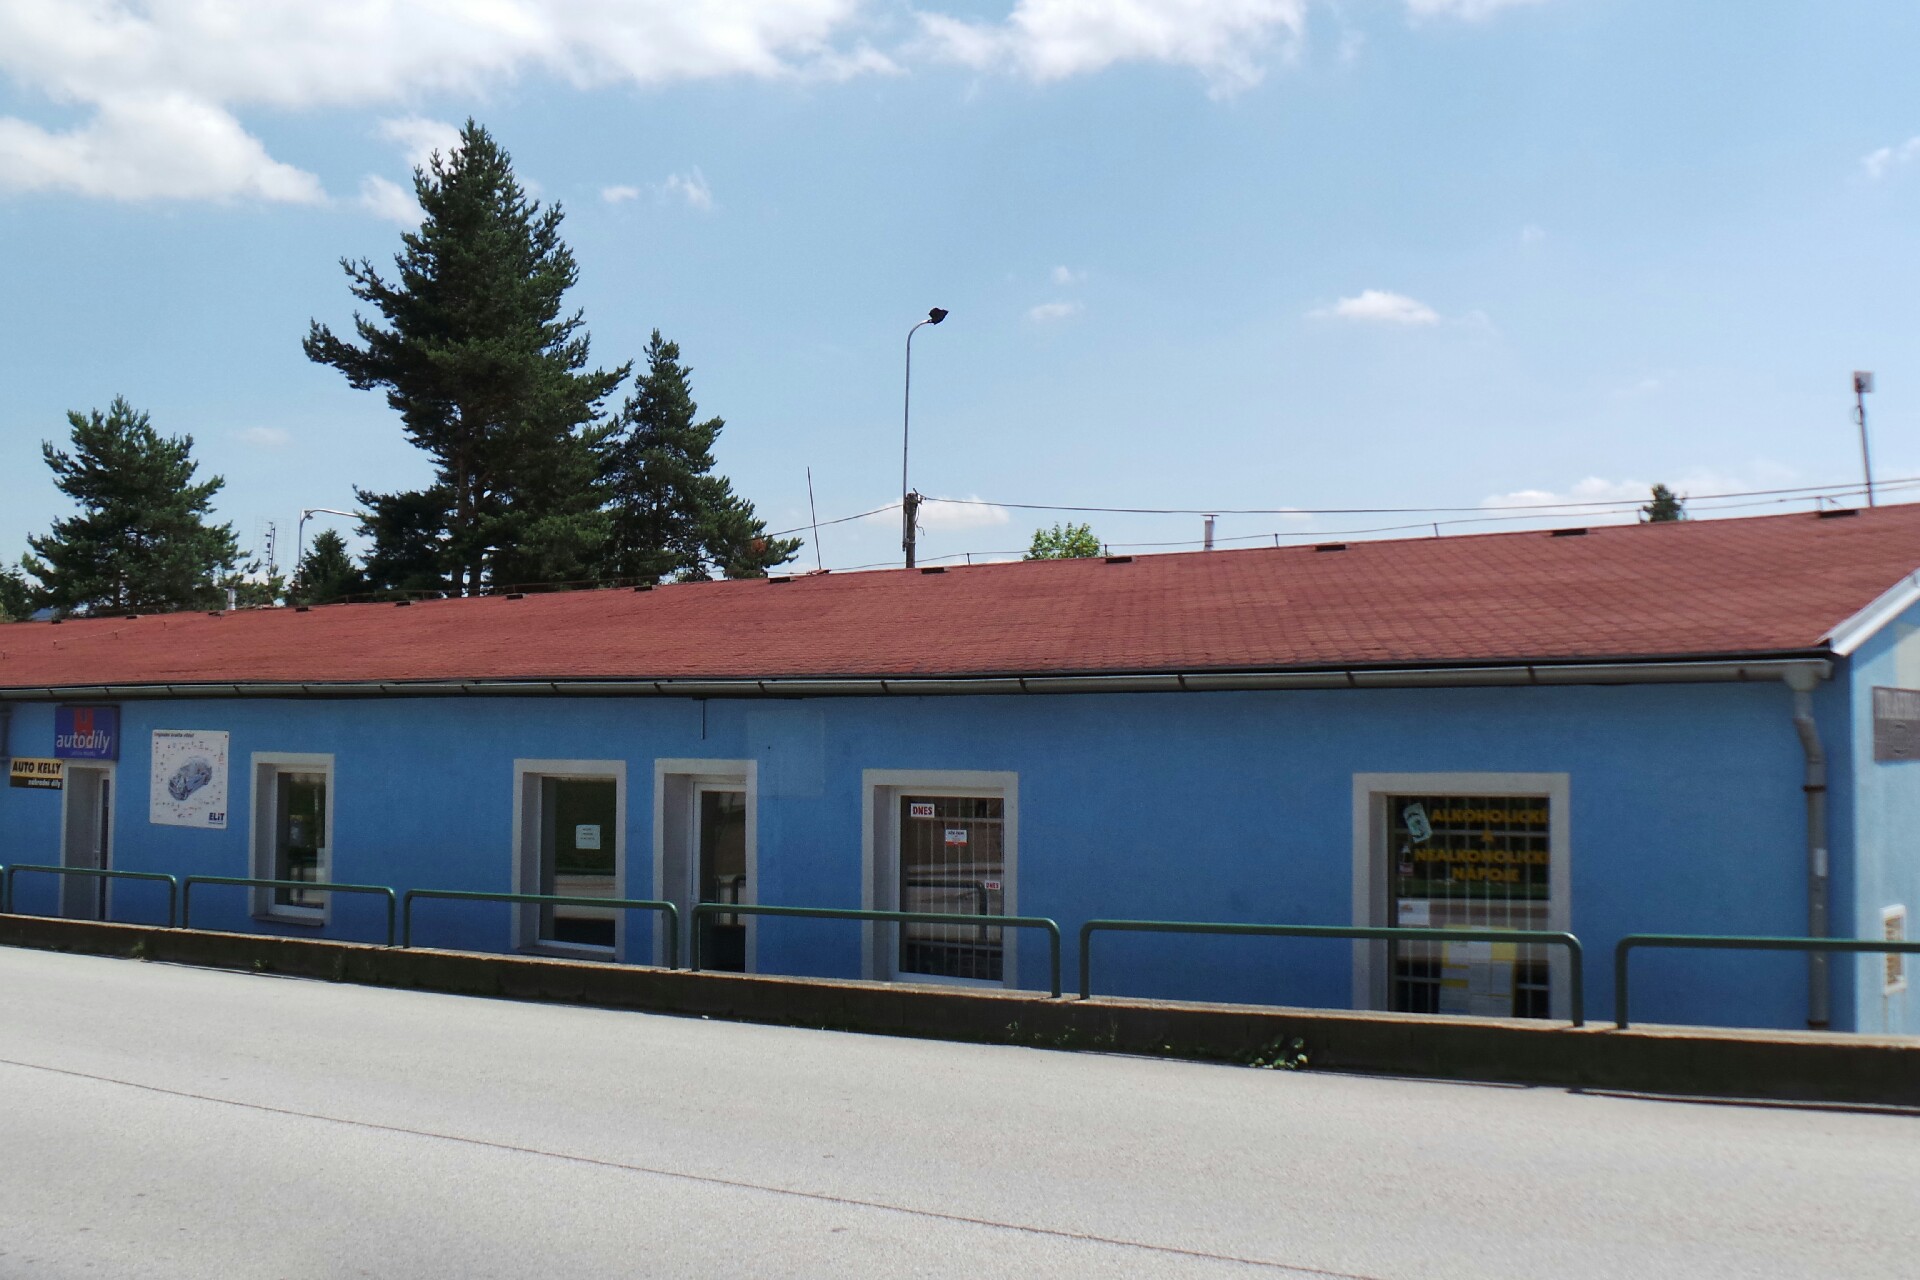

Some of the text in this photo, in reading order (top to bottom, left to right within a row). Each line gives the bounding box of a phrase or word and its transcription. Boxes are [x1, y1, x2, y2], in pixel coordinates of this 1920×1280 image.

[12, 761, 61, 775] AUTO KELLY
[912, 806, 933, 815] DNES
